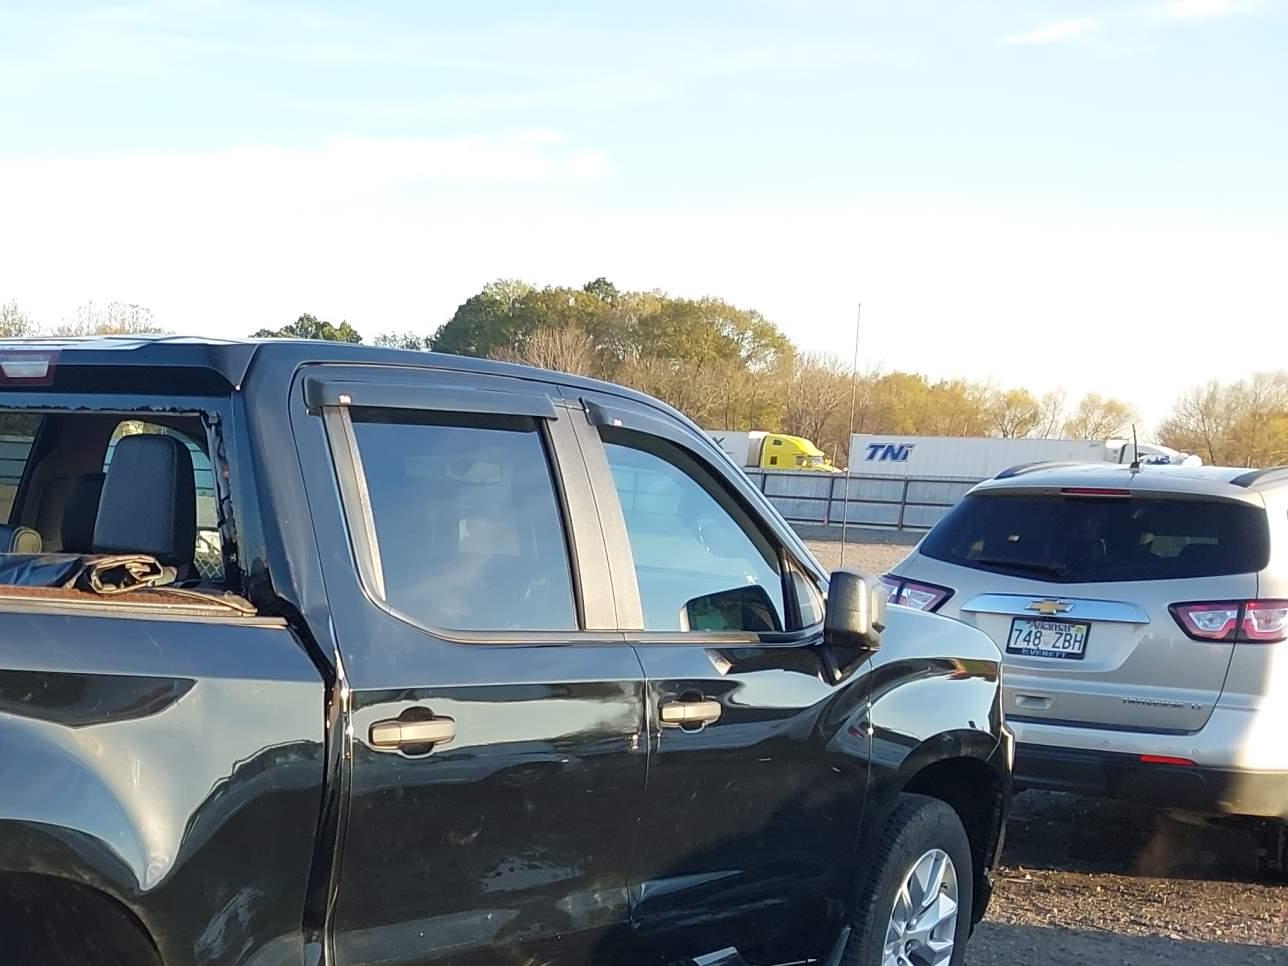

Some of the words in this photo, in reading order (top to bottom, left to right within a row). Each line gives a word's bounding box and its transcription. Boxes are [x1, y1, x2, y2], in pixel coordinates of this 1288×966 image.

[1014, 629, 1043, 647] 748
[1052, 632, 1084, 650] ZBH
[1022, 648, 1067, 658] EVERETT
